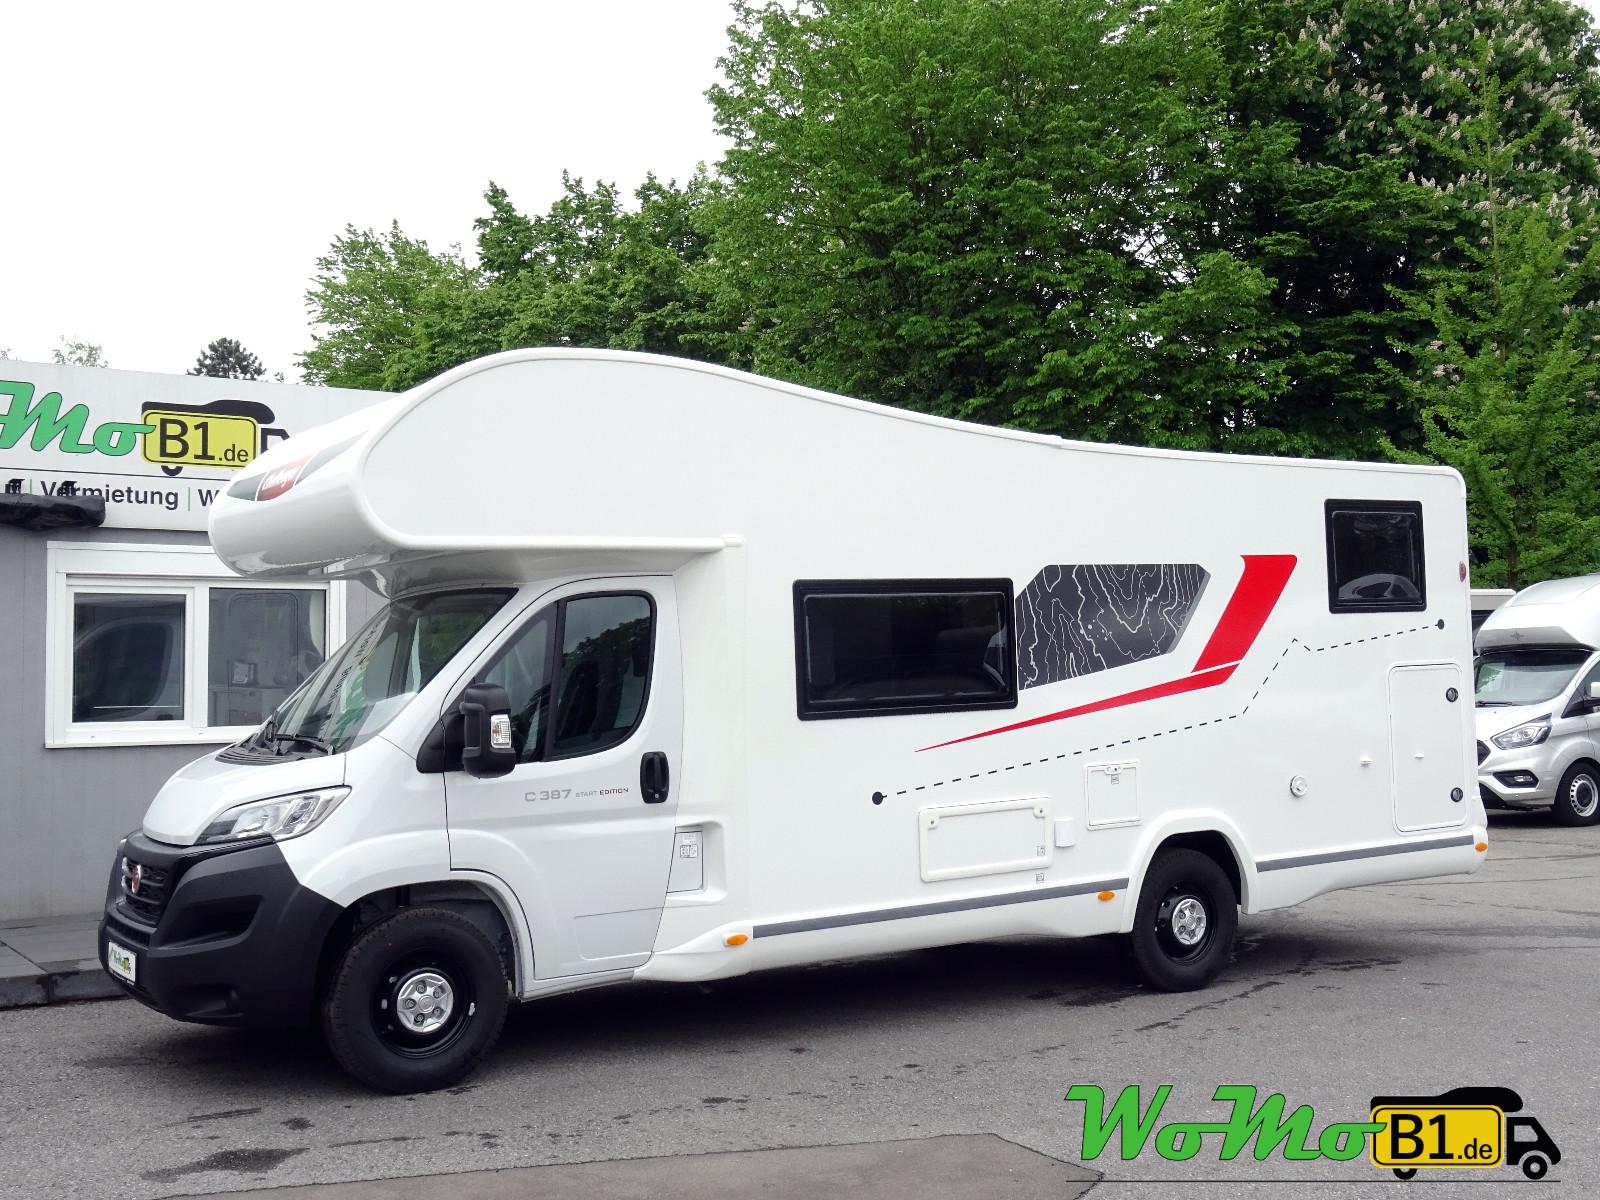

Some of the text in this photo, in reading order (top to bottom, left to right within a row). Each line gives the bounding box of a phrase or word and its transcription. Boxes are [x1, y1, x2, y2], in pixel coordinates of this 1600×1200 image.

[160, 418, 249, 462] B1.de
[524, 791, 537, 802] C
[540, 789, 572, 801] 387
[599, 787, 629, 796] EDITION
